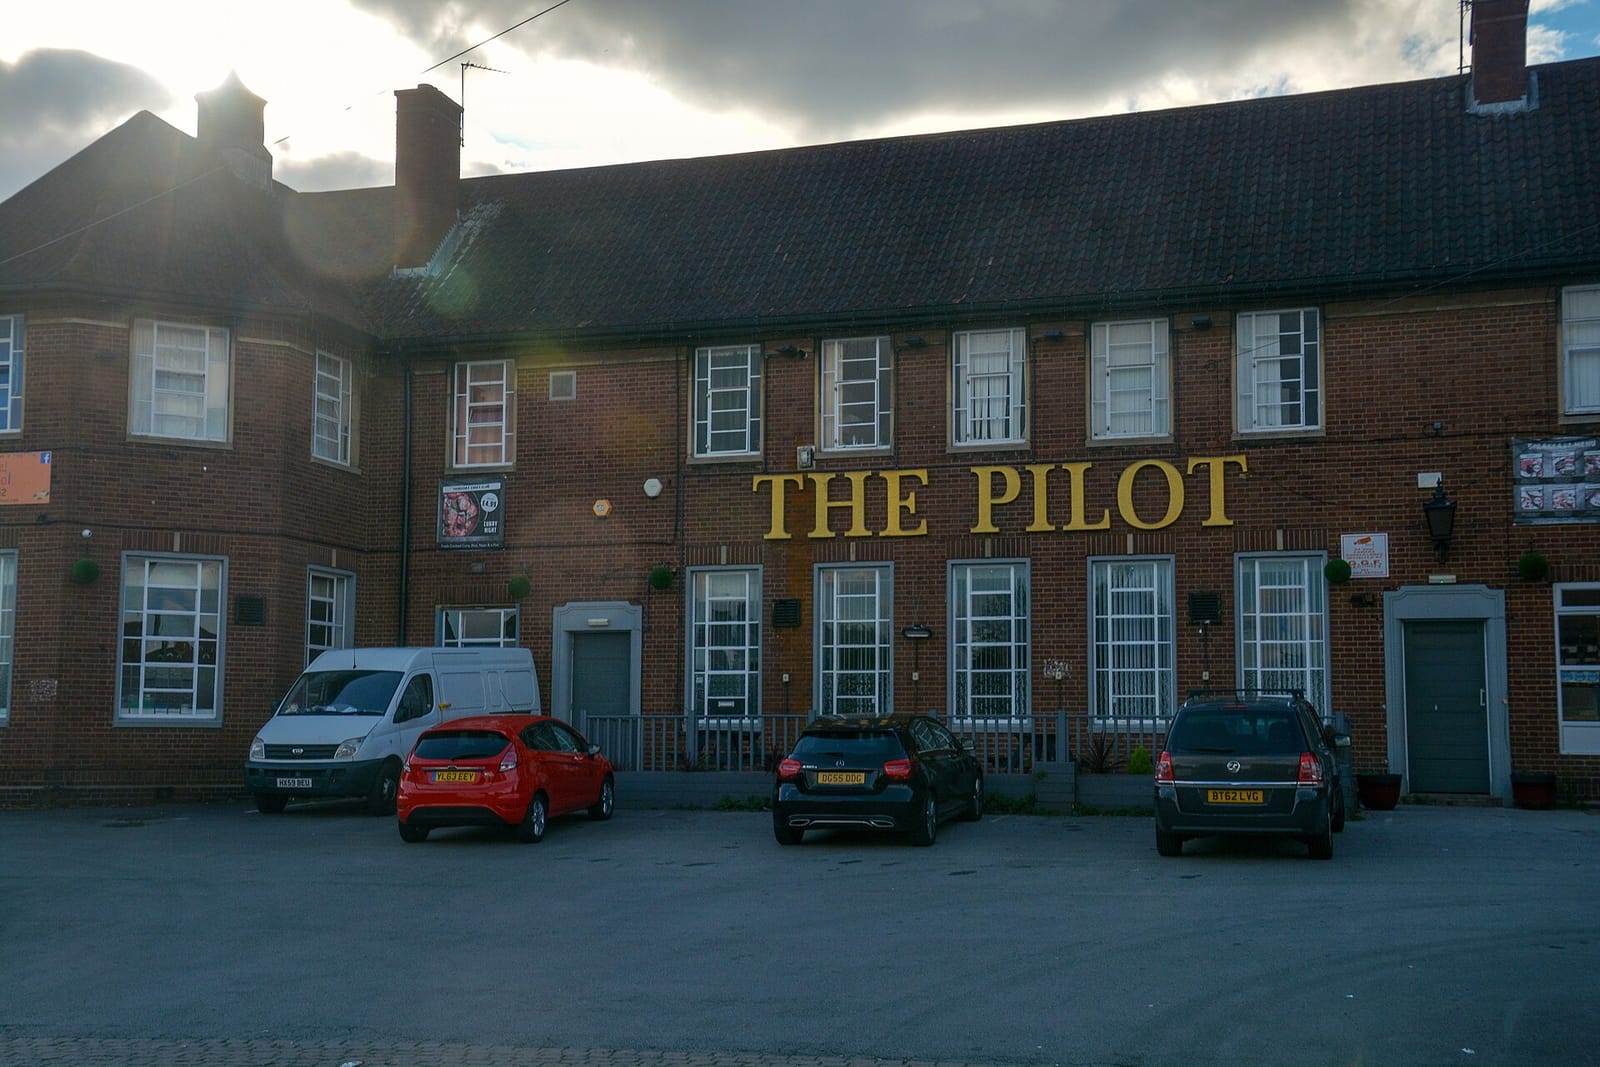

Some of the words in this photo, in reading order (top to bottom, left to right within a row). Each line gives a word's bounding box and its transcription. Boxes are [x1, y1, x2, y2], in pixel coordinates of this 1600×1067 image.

[752, 468, 929, 540] THE
[970, 455, 1249, 533] PILOT
[437, 772, 456, 780] YL63
[458, 772, 474, 780] EEY
[1212, 790, 1238, 801] BT62
[1239, 790, 1259, 801] LVG
